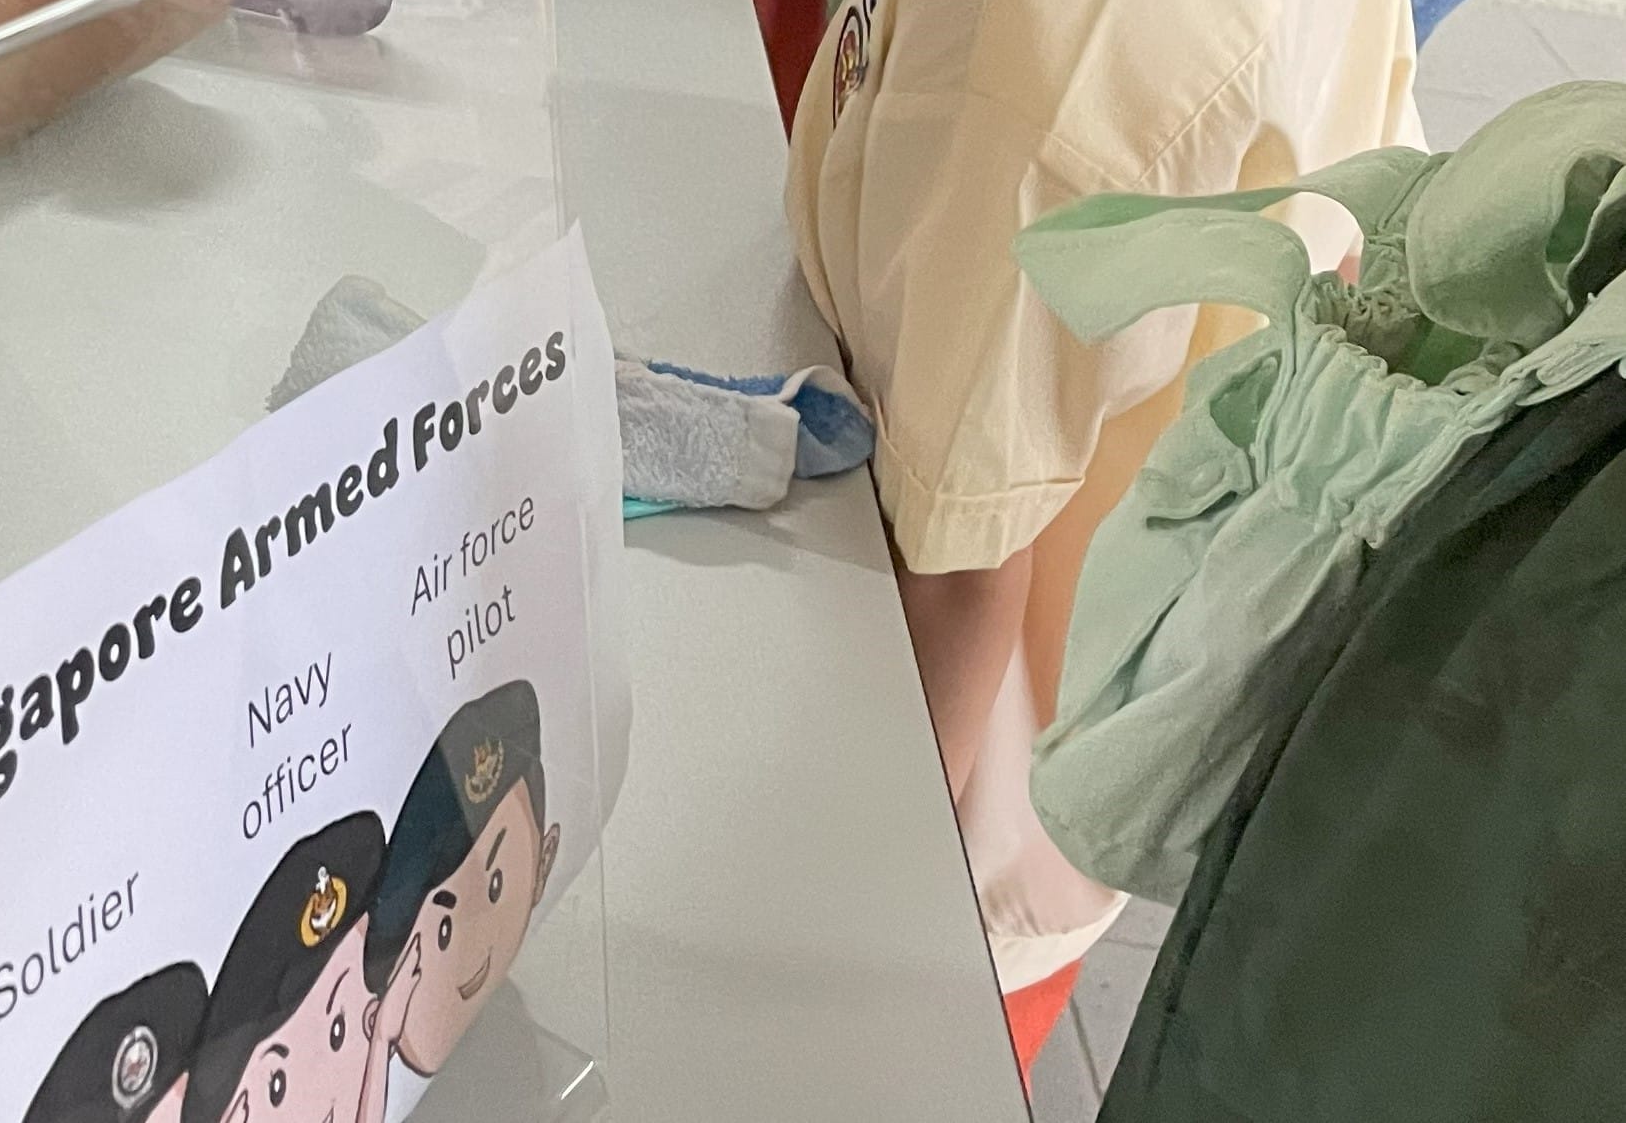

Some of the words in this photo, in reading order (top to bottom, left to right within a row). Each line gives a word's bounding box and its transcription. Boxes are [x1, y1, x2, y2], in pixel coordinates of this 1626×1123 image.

[218, 417, 400, 610] Armed
[411, 329, 567, 472] Forces
[410, 552, 455, 616] Air
[455, 496, 537, 585] force
[443, 585, 519, 679] pilot
[246, 652, 338, 749] Navy
[239, 722, 355, 841] officer
